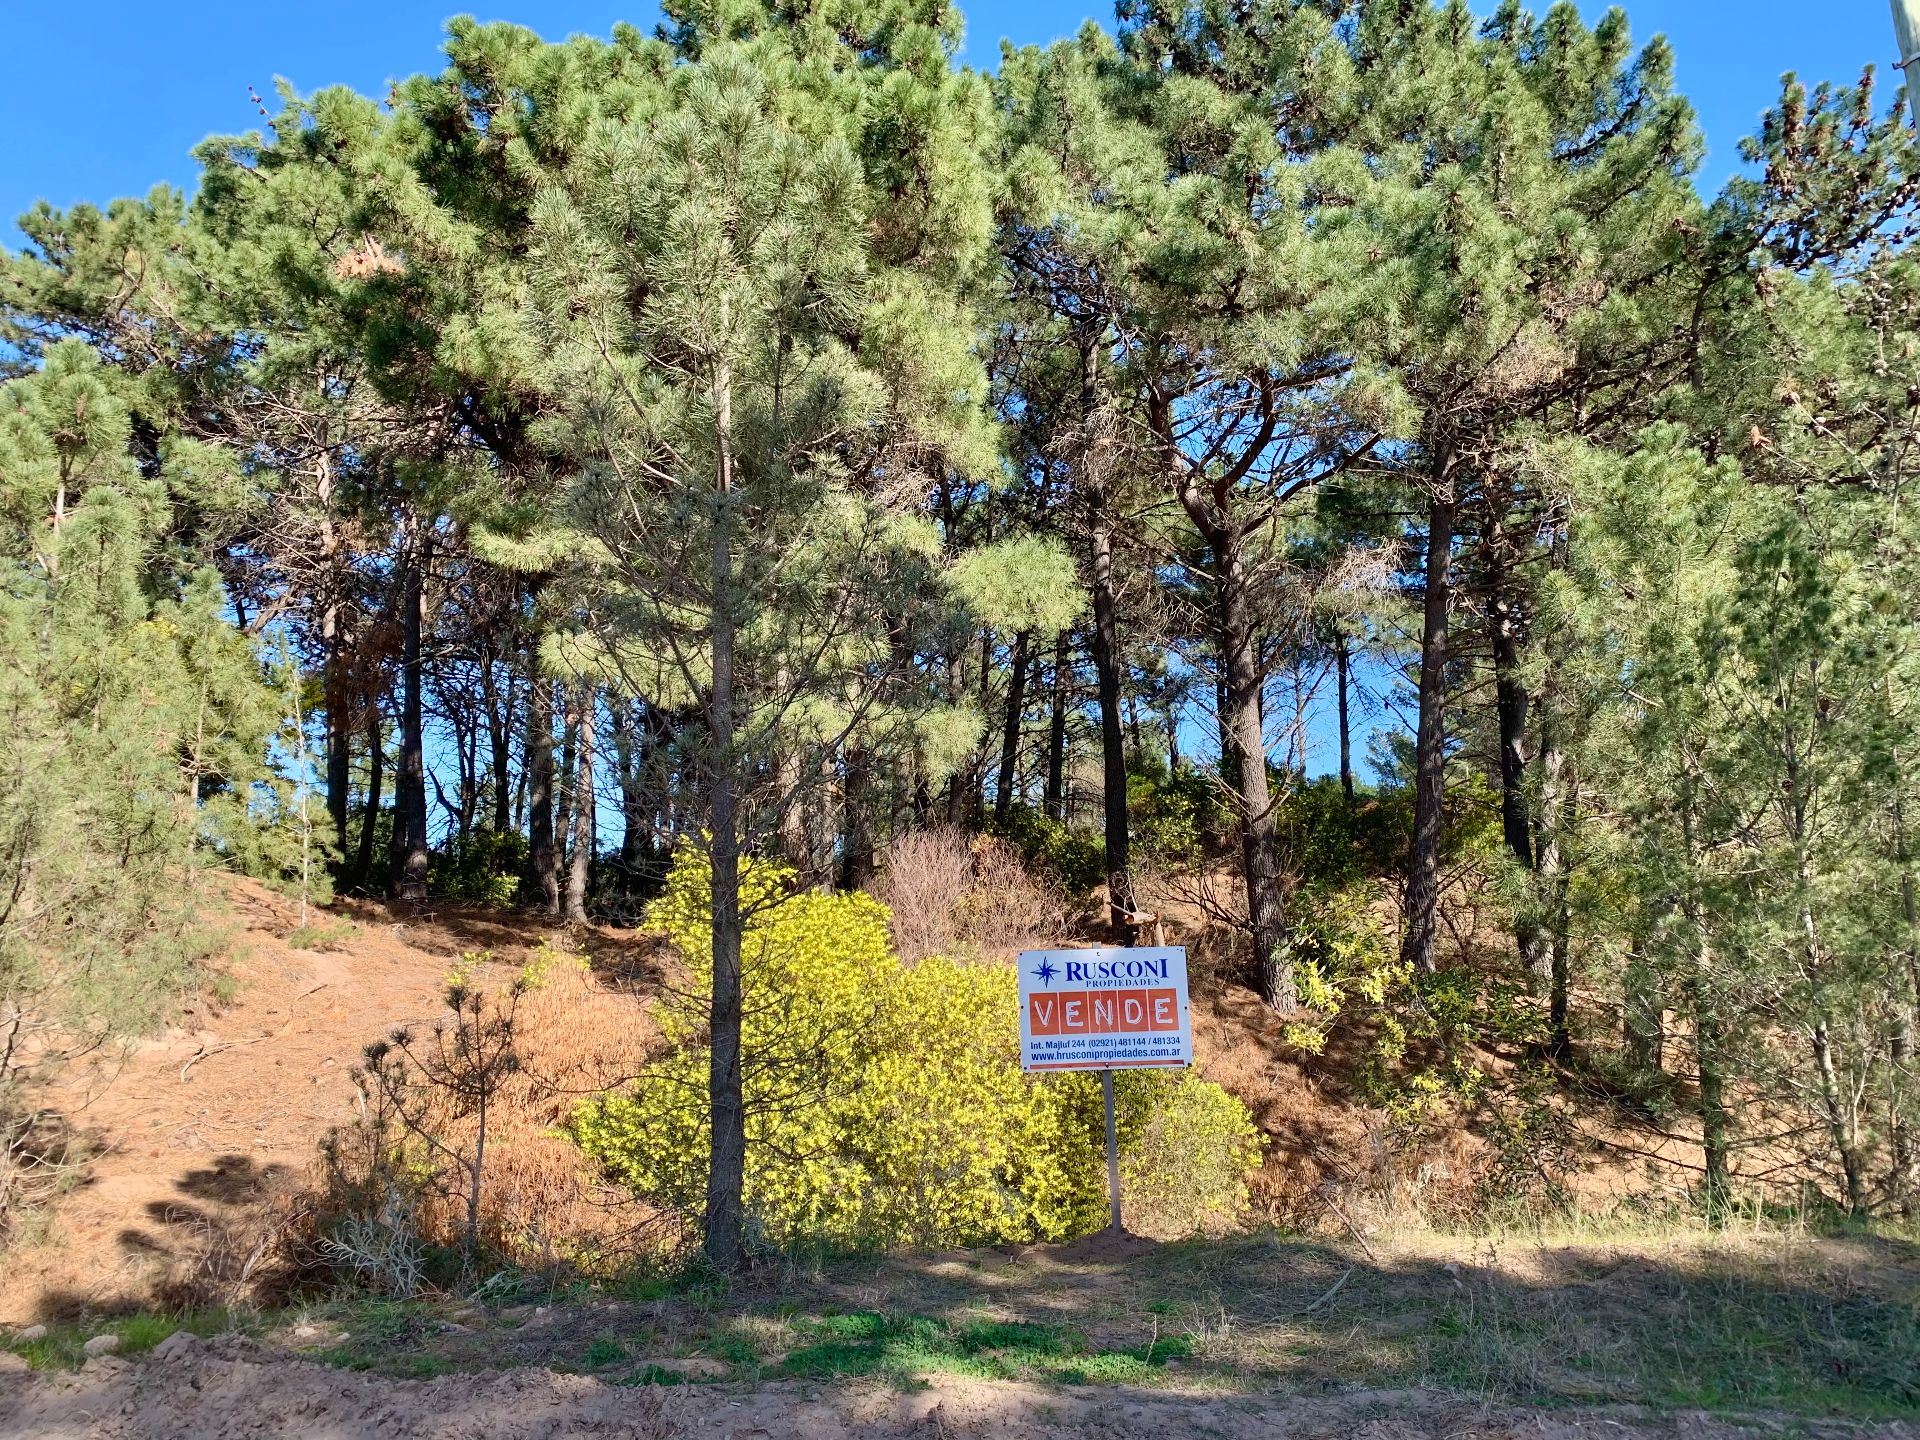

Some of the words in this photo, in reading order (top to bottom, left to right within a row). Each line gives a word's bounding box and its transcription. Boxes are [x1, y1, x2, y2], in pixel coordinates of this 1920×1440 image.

[1065, 958, 1168, 982] RUSCONI
[1086, 978, 1160, 988] PROPIEDADES
[1034, 997, 1174, 1028] VENDE
[1030, 1042, 1044, 1050] Int.
[1045, 1040, 1071, 1050] Majluf
[1071, 1039, 1086, 1048] 244
[1088, 1038, 1117, 1048] (02921)
[1118, 1037, 1146, 1047] 481144
[1152, 1037, 1181, 1046] 481334
[1031, 1048, 1181, 1061] www.hrusconipropiedades.com.ar
